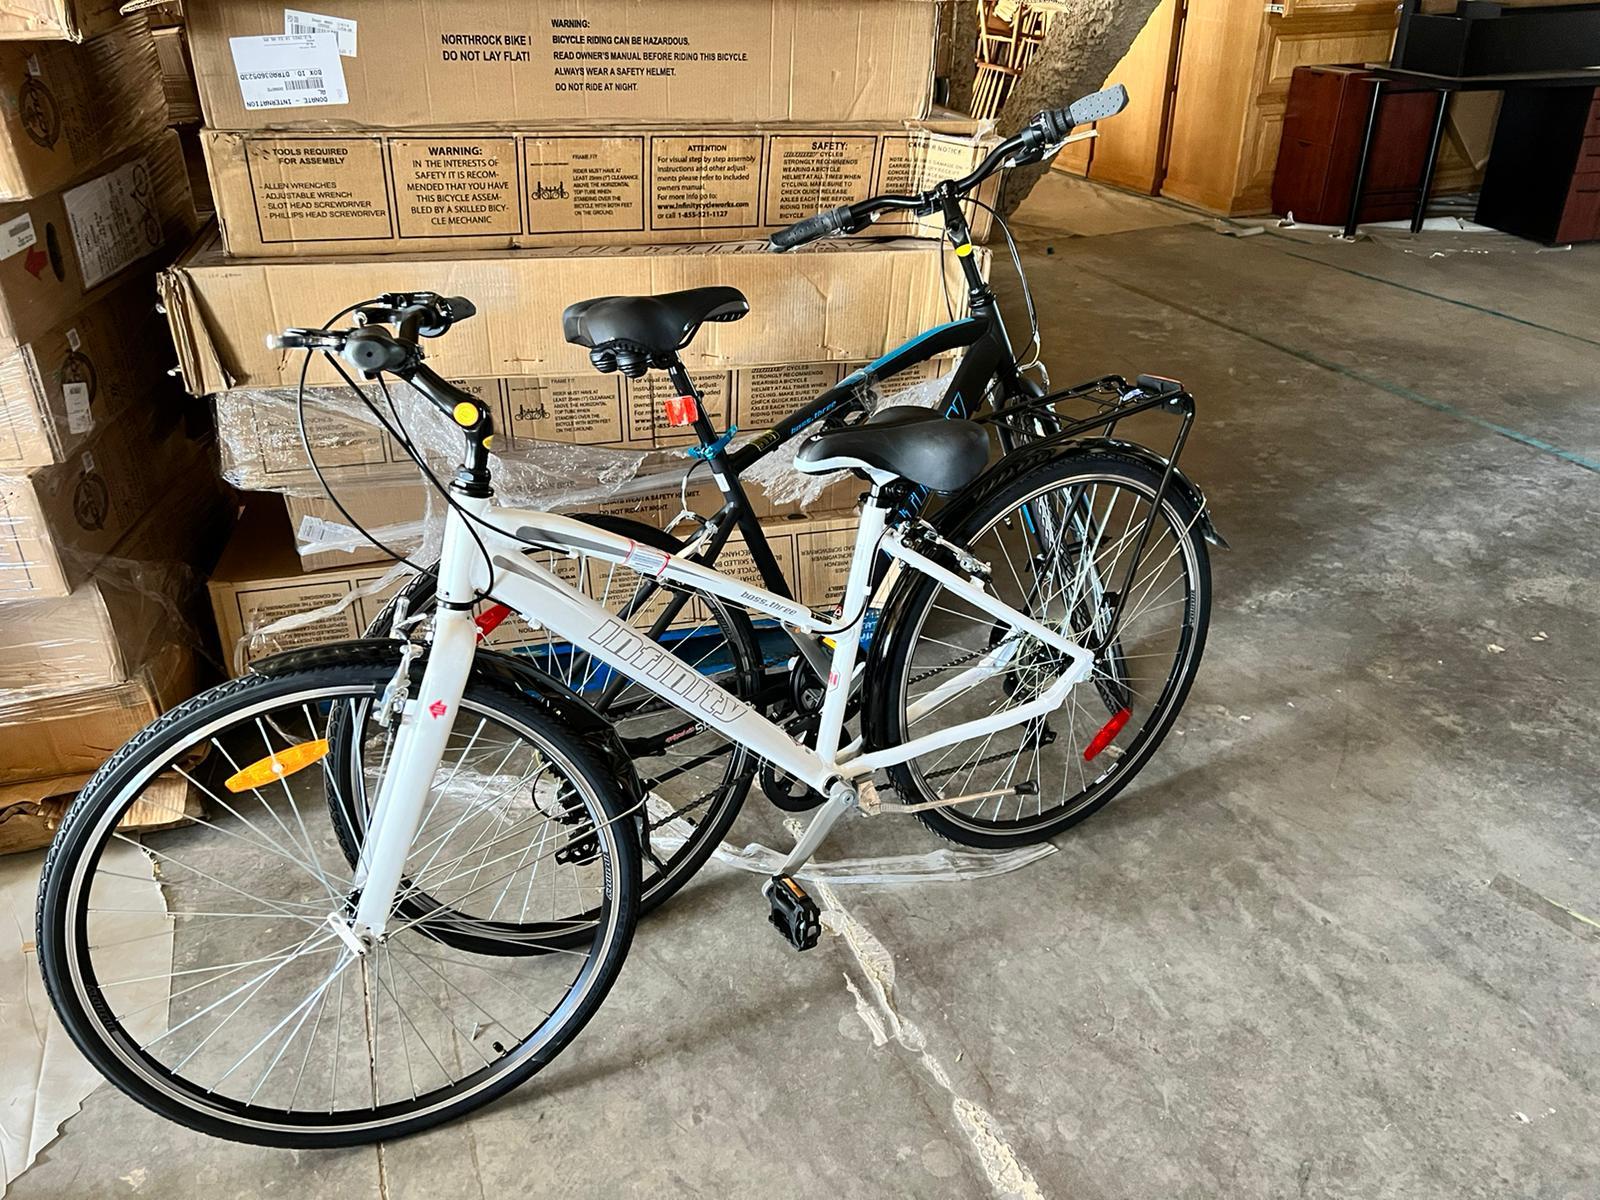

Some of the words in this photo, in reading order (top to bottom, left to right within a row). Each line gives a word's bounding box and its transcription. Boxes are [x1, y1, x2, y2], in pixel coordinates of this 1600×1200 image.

[552, 19, 590, 28] WARNING:
[442, 34, 501, 46] NORTHROCK
[505, 35, 526, 46] BIKE
[553, 36, 584, 44] BICYCLE
[586, 36, 612, 45] RIDING
[613, 36, 629, 45] CAN
[631, 36, 641, 45] BE
[642, 36, 689, 45] HAZARDOUS.
[443, 50, 457, 62] DO
[460, 50, 480, 62] NOT
[483, 51, 501, 62] LAY
[504, 51, 530, 62] FLAT!
[554, 52, 574, 60] READ
[575, 52, 609, 60] OWNER'S
[610, 52, 641, 61] MANUAL
[642, 52, 672, 61] BEFORE
[673, 52, 698, 61] RIDING
[700, 53, 715, 61] THIS
[716, 53, 747, 61] BICYCLE.
[587, 68, 609, 76] WEAR
[611, 68, 616, 76] A
[618, 68, 645, 76] SAFETY
[646, 68, 676, 76] HELMET.
[556, 83, 566, 91] DO
[568, 83, 582, 91] NOT
[585, 83, 602, 91] RIDE
[604, 83, 612, 91] AT
[614, 83, 638, 91] NIGHT.
[247, 99, 292, 107] INTERNATION
[812, 142, 848, 150] SAFETY:
[273, 148, 302, 156] TOOLS
[304, 148, 348, 156] REQUIRED
[429, 146, 482, 156] WARNING:
[279, 157, 296, 165] FOR
[299, 157, 345, 165] ASSEMBLY
[413, 159, 421, 168] IN
[426, 159, 441, 168] THE
[443, 159, 486, 168] INTERESTS
[488, 159, 499, 167] OF
[416, 171, 446, 179] SAFETY
[264, 182, 289, 190] ALLEN
[290, 181, 336, 190] WRENCHES
[407, 182, 444, 191] MENDED
[446, 182, 466, 191] THAT
[468, 182, 485, 190] YOU
[488, 182, 508, 190] HAVE
[266, 191, 315, 200] ADJUSTABLE
[317, 191, 352, 199] WRENCH
[417, 194, 434, 203] THIS
[437, 194, 469, 202] BICYCLE
[472, 193, 502, 202] ASSEM-
[268, 201, 287, 210] SLOT
[291, 201, 312, 209] HEAD
[314, 200, 371, 209] SCREWDRIVER
[412, 205, 432, 214] BLED
[434, 205, 444, 214] BY
[446, 205, 452, 213] A
[455, 204, 486, 213] SKILLED
[488, 204, 509, 212] BICY-
[270, 211, 303, 220] PHILLIPS
[306, 210, 327, 219] HEAD
[329, 210, 386, 219] SCREWDRIVER
[432, 217, 446, 225] CLE
[448, 216, 491, 225] MECHANIC
[740, 590, 798, 617] boss.three
